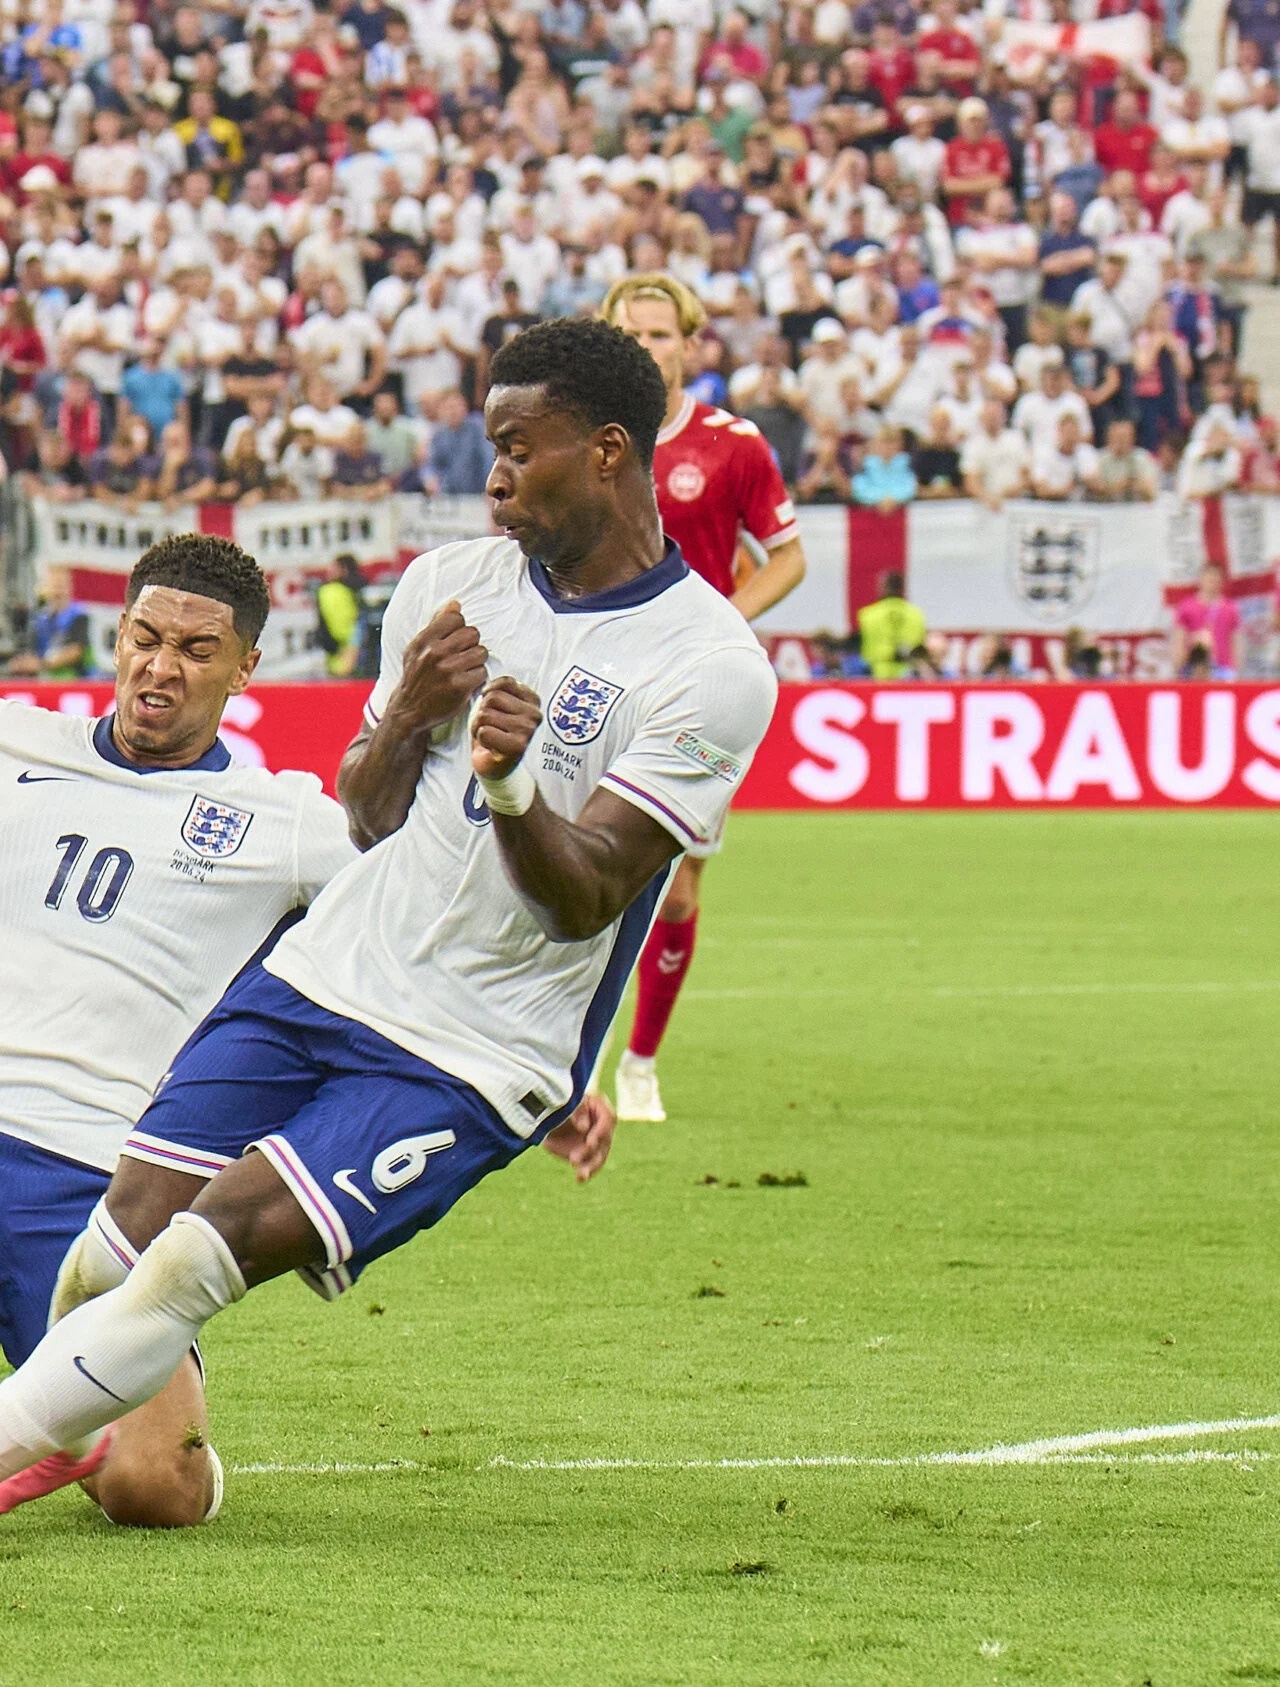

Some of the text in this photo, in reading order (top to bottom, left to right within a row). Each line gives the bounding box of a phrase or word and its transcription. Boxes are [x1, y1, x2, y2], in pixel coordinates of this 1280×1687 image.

[541, 742, 583, 769] DENMARK
[45, 833, 134, 924] 10
[371, 1128, 456, 1194] 6
